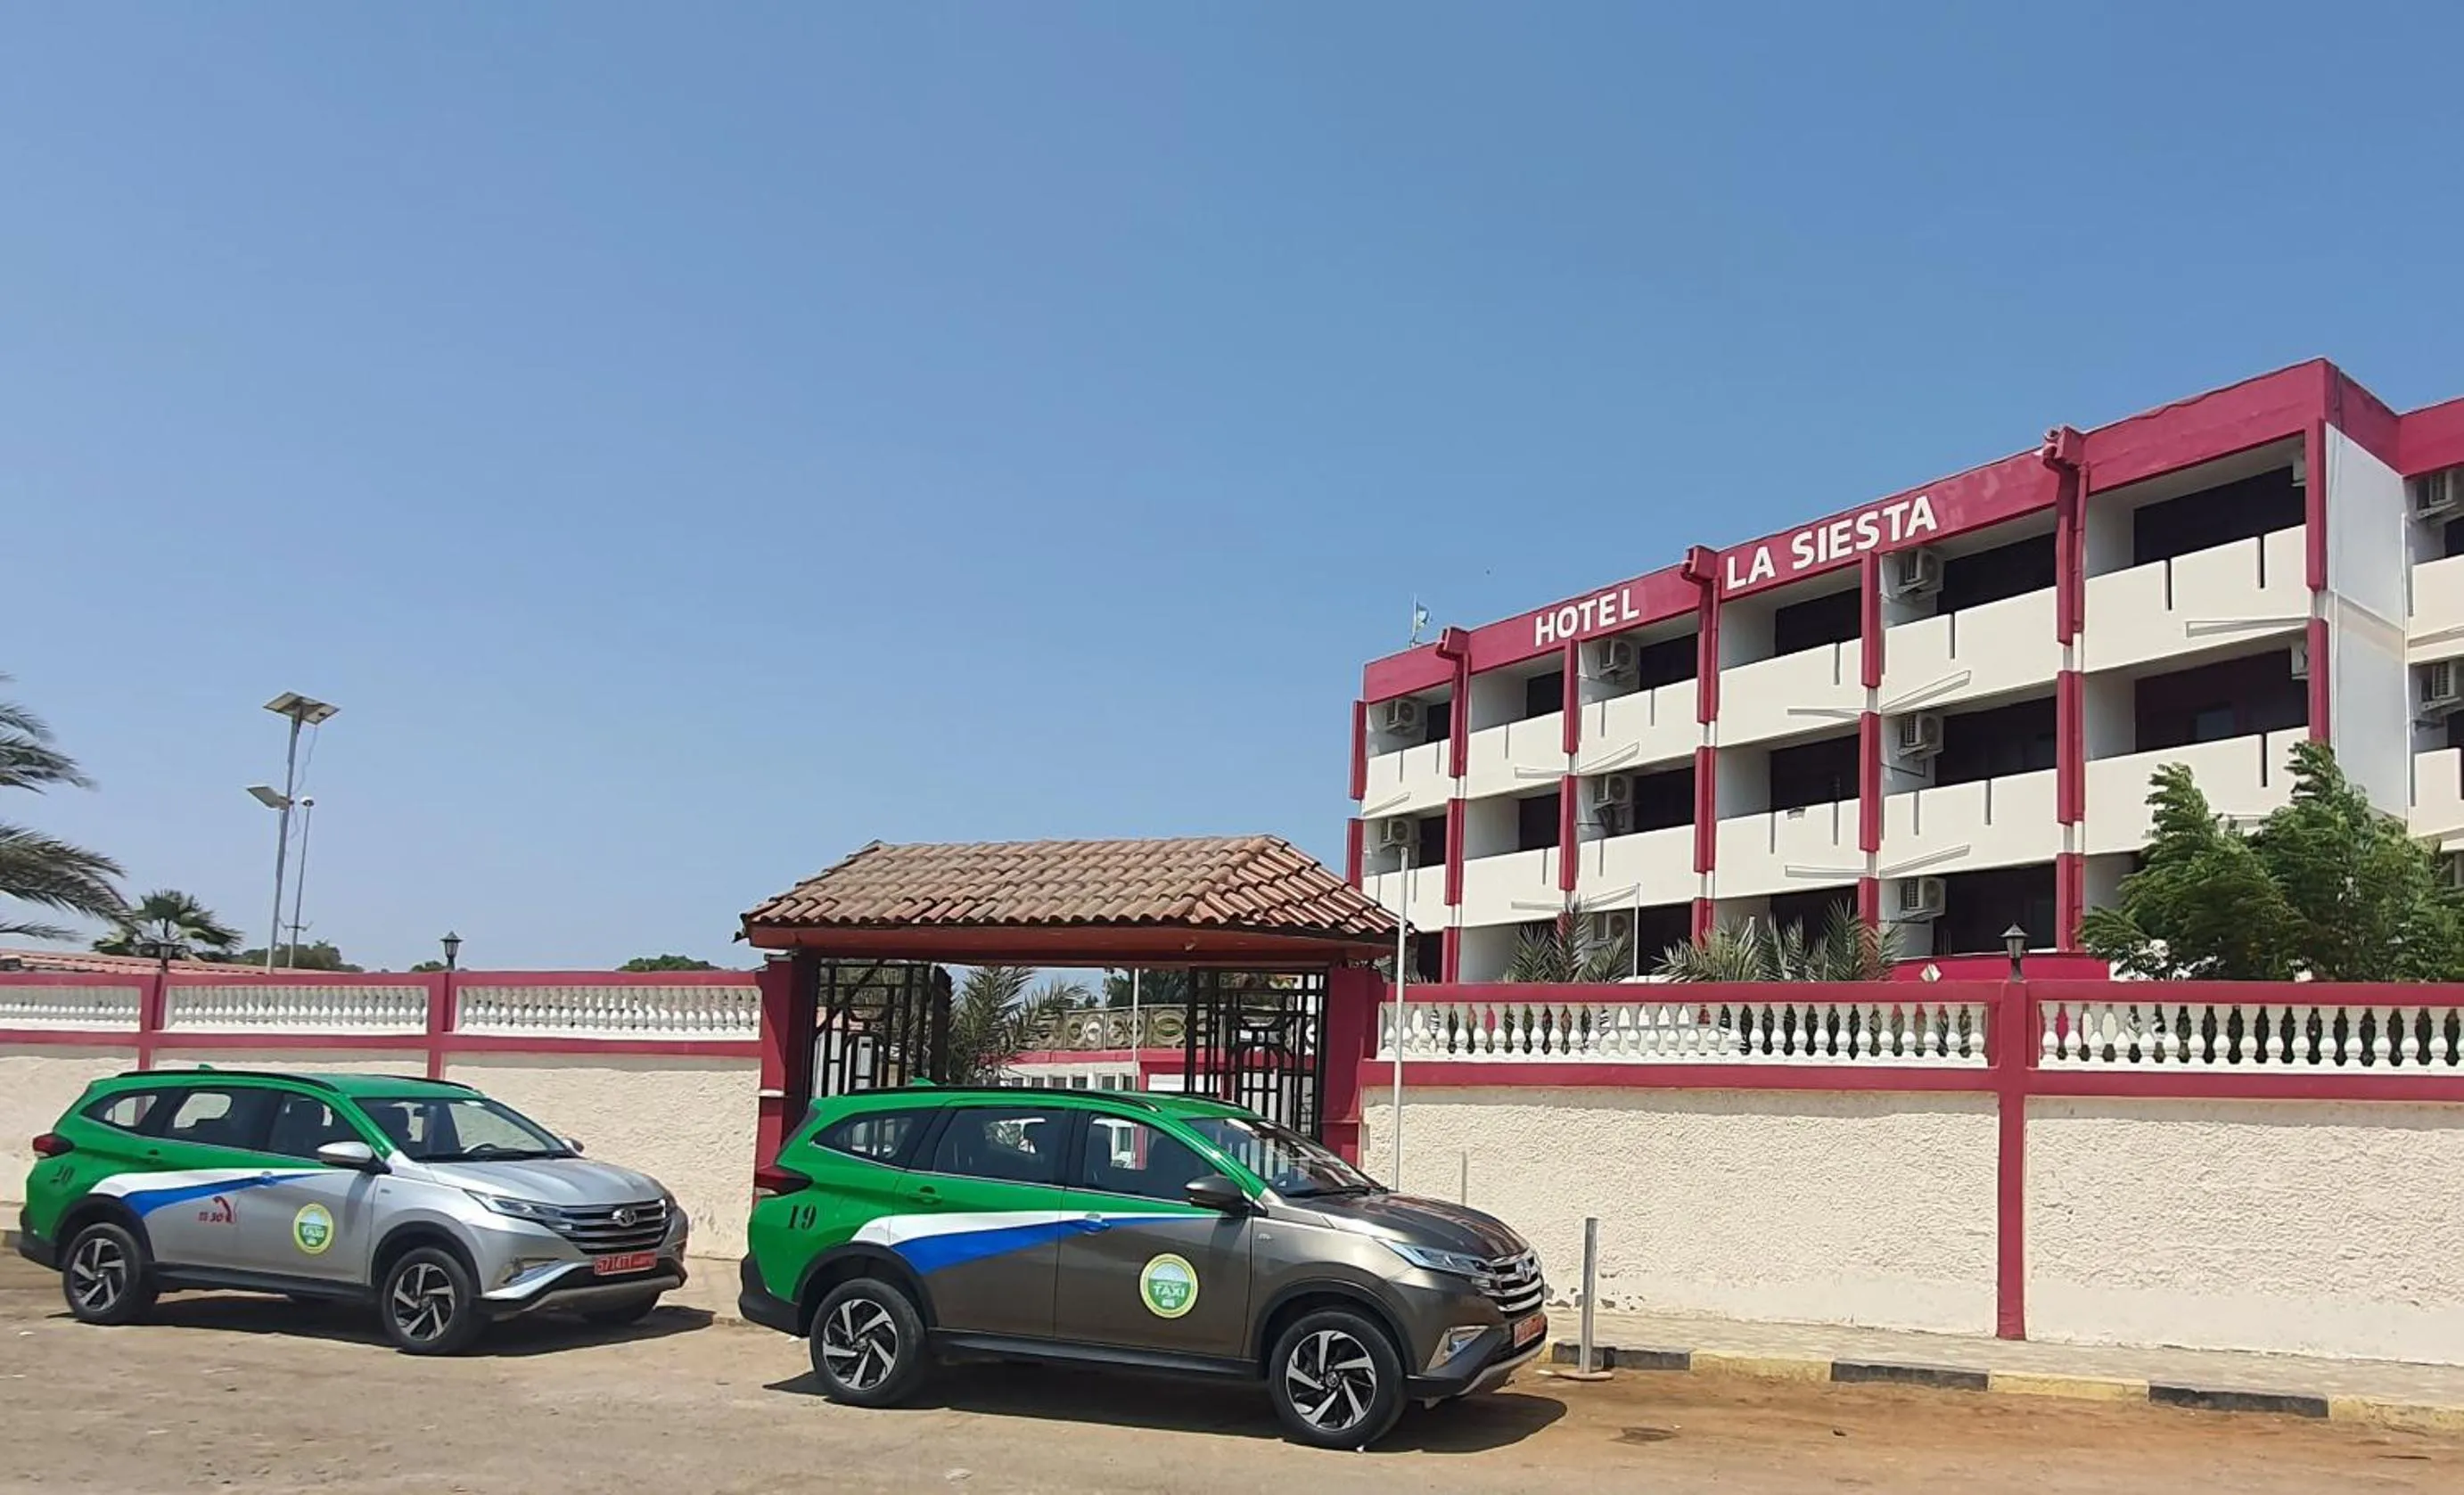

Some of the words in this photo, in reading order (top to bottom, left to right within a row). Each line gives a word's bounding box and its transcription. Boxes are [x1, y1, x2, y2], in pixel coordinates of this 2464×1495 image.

[1534, 587, 1640, 647] HOTEL
[1726, 546, 1777, 591] LA
[1791, 495, 1938, 571] SIESTA
[788, 1203, 817, 1230] 19
[1153, 1284, 1186, 1299] TAXI
